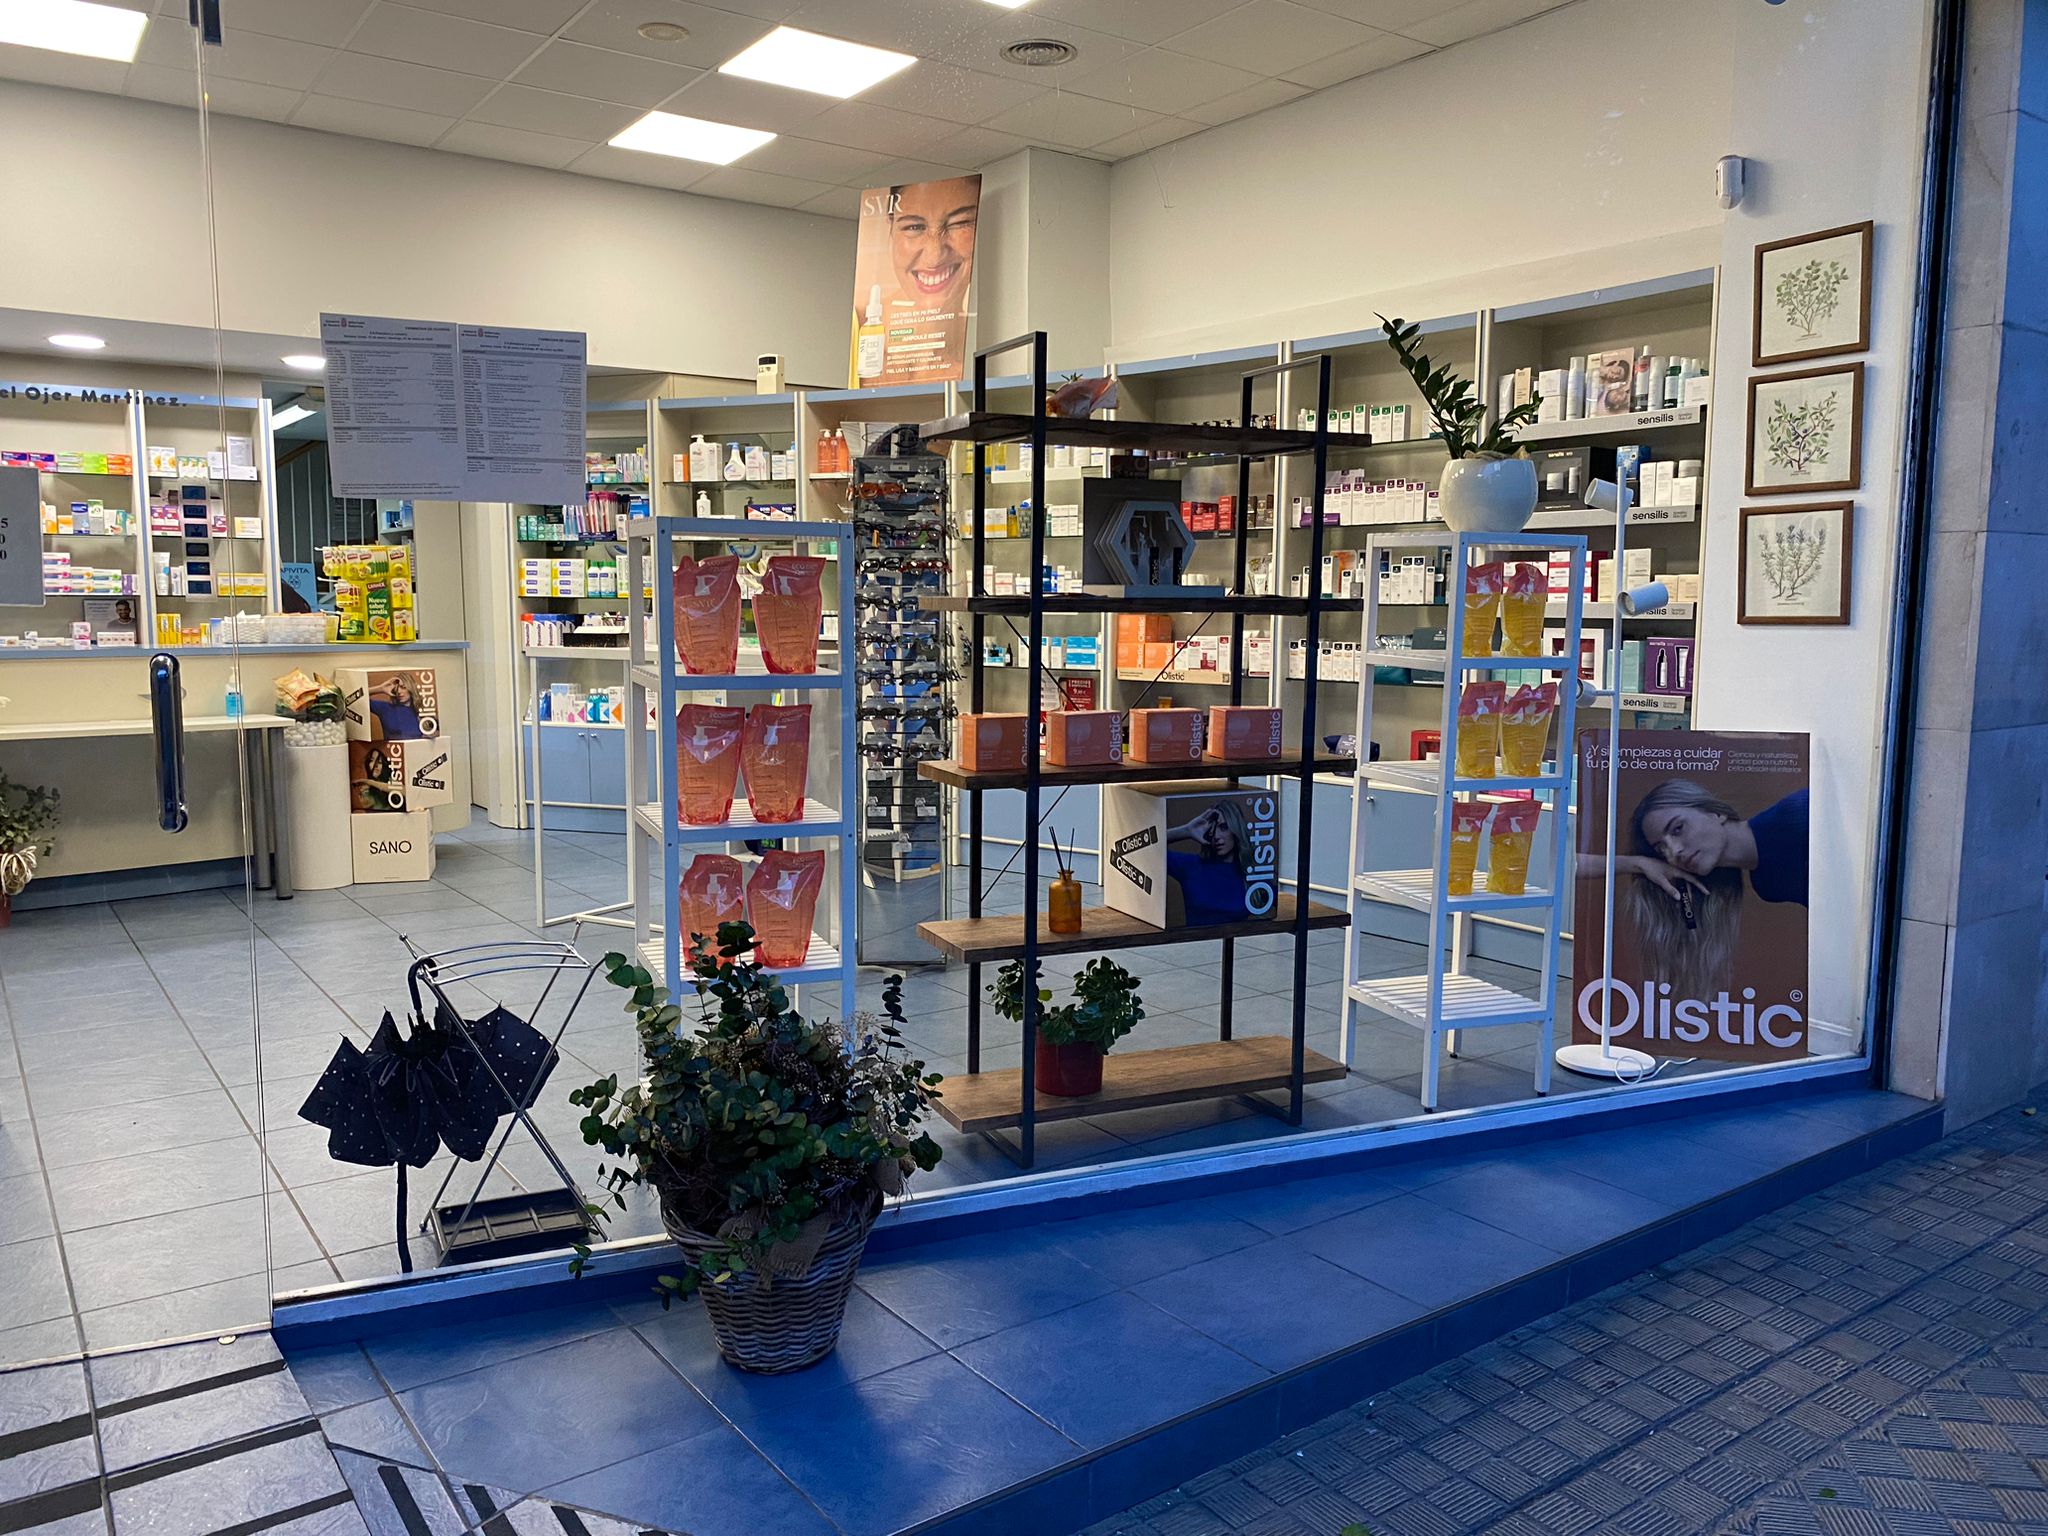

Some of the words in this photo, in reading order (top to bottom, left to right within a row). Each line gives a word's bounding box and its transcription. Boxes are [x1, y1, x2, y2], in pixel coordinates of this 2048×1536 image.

[864, 193, 903, 216] SVR
[25, 387, 72, 404] Ojer
[1637, 413, 1674, 425] sensilis
[1632, 510, 1669, 520] sensilis
[1162, 672, 1185, 680] Olistic
[419, 671, 437, 736] Olistic
[1623, 698, 1658, 708] sensilis
[1108, 714, 1121, 761] Olistic
[1189, 713, 1201, 758] Olistic
[1267, 710, 1282, 756] Olistic
[1586, 745, 1599, 759] ¿Y
[1618, 746, 1672, 759] mpiezas
[1674, 750, 1681, 758] a
[1683, 747, 1723, 759] cuidar
[1586, 759, 1598, 768] tu
[1601, 758, 1628, 770] plo
[1631, 759, 1648, 769] de
[1650, 760, 1674, 770] otra
[1676, 759, 1720, 771] forma?
[388, 743, 404, 808] Olistic
[370, 840, 412, 854] SANO
[1122, 836, 1142, 853] Olistic
[1245, 797, 1275, 916] Olistic
[1116, 857, 1137, 881] Olistic
[1578, 978, 1803, 1048] Olistic
